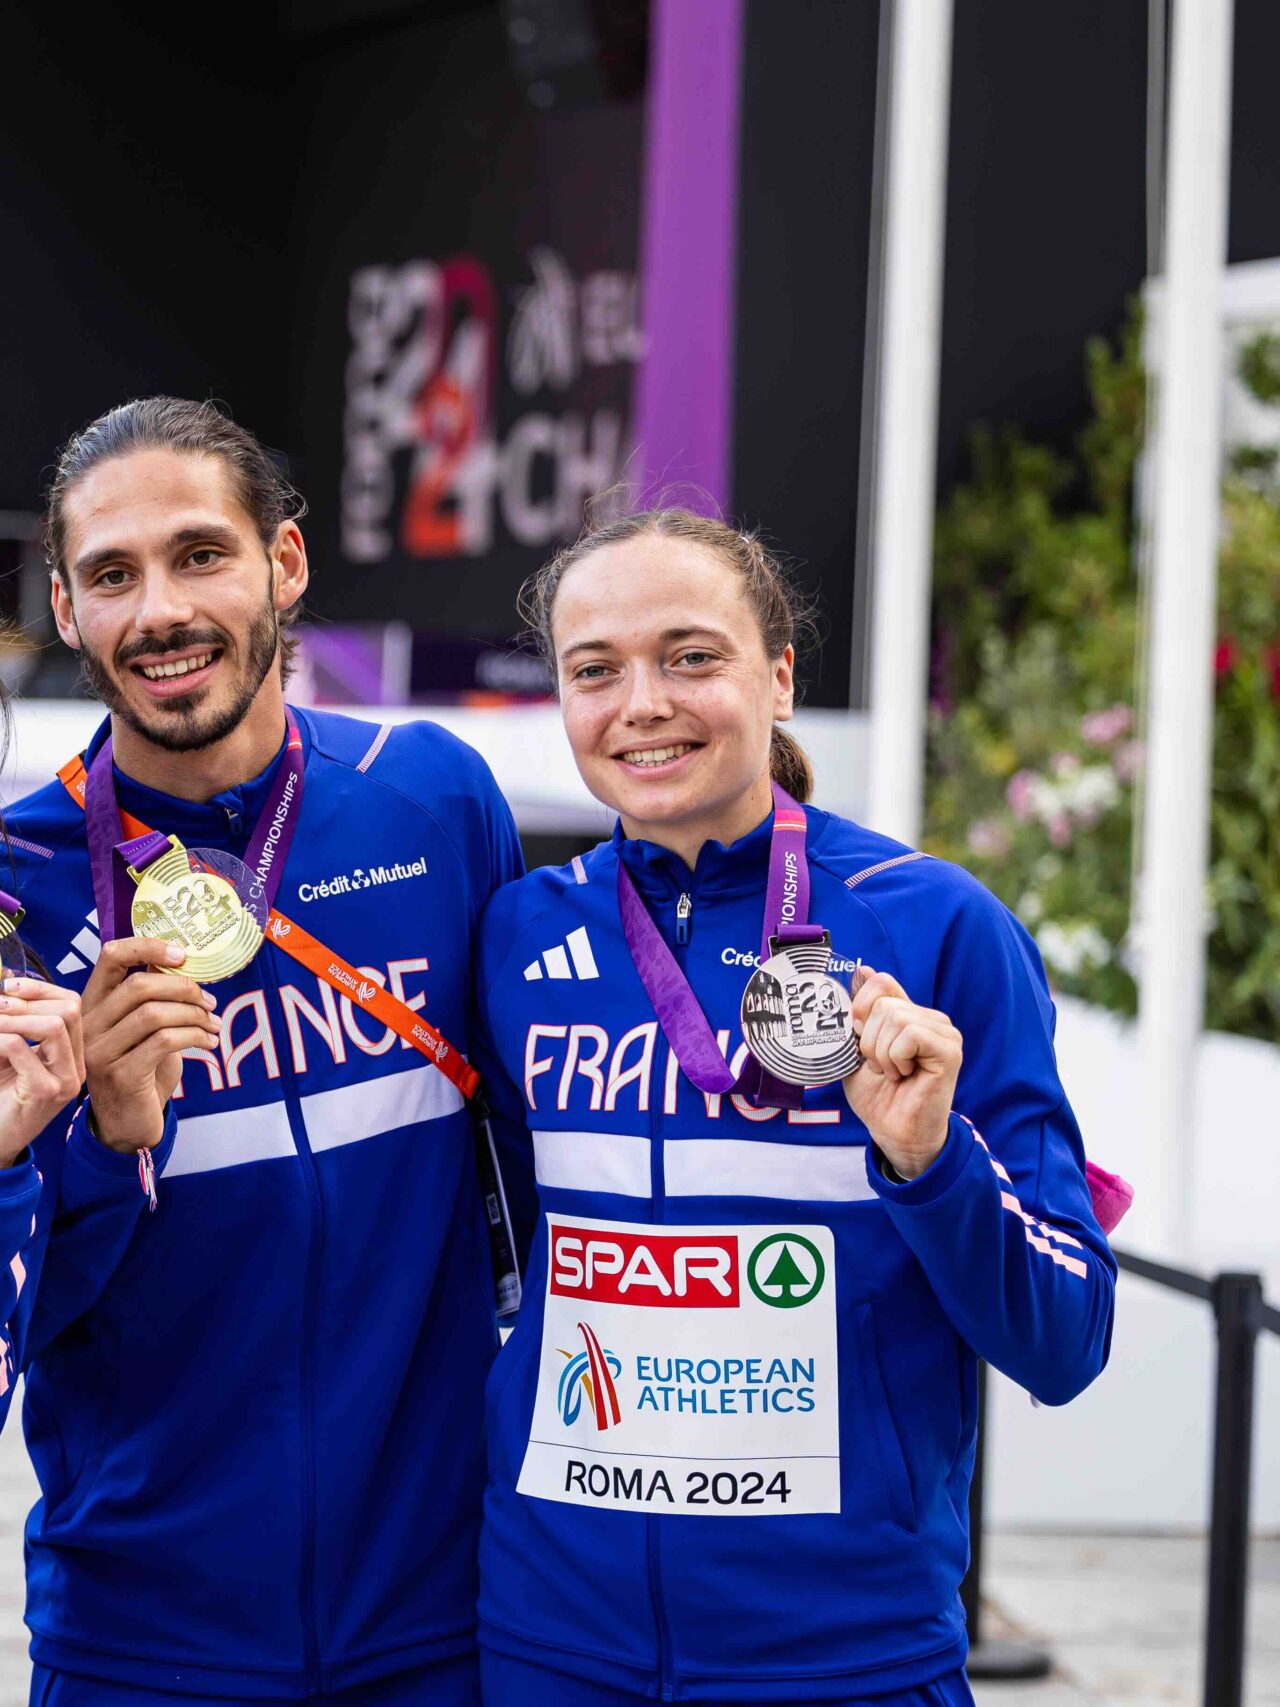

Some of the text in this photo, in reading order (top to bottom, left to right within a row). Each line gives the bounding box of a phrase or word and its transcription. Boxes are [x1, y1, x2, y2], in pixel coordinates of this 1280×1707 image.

[249, 771, 298, 899] CHAMPIONSHIPS
[298, 857, 428, 902] Crédit Mutuel
[785, 983, 804, 1034] roma
[554, 1236, 732, 1297] SPAR
[636, 1355, 815, 1384] EUROPEAN
[636, 1385, 815, 1414] ATHLETICS
[564, 1459, 792, 1505] ROMA 2024
